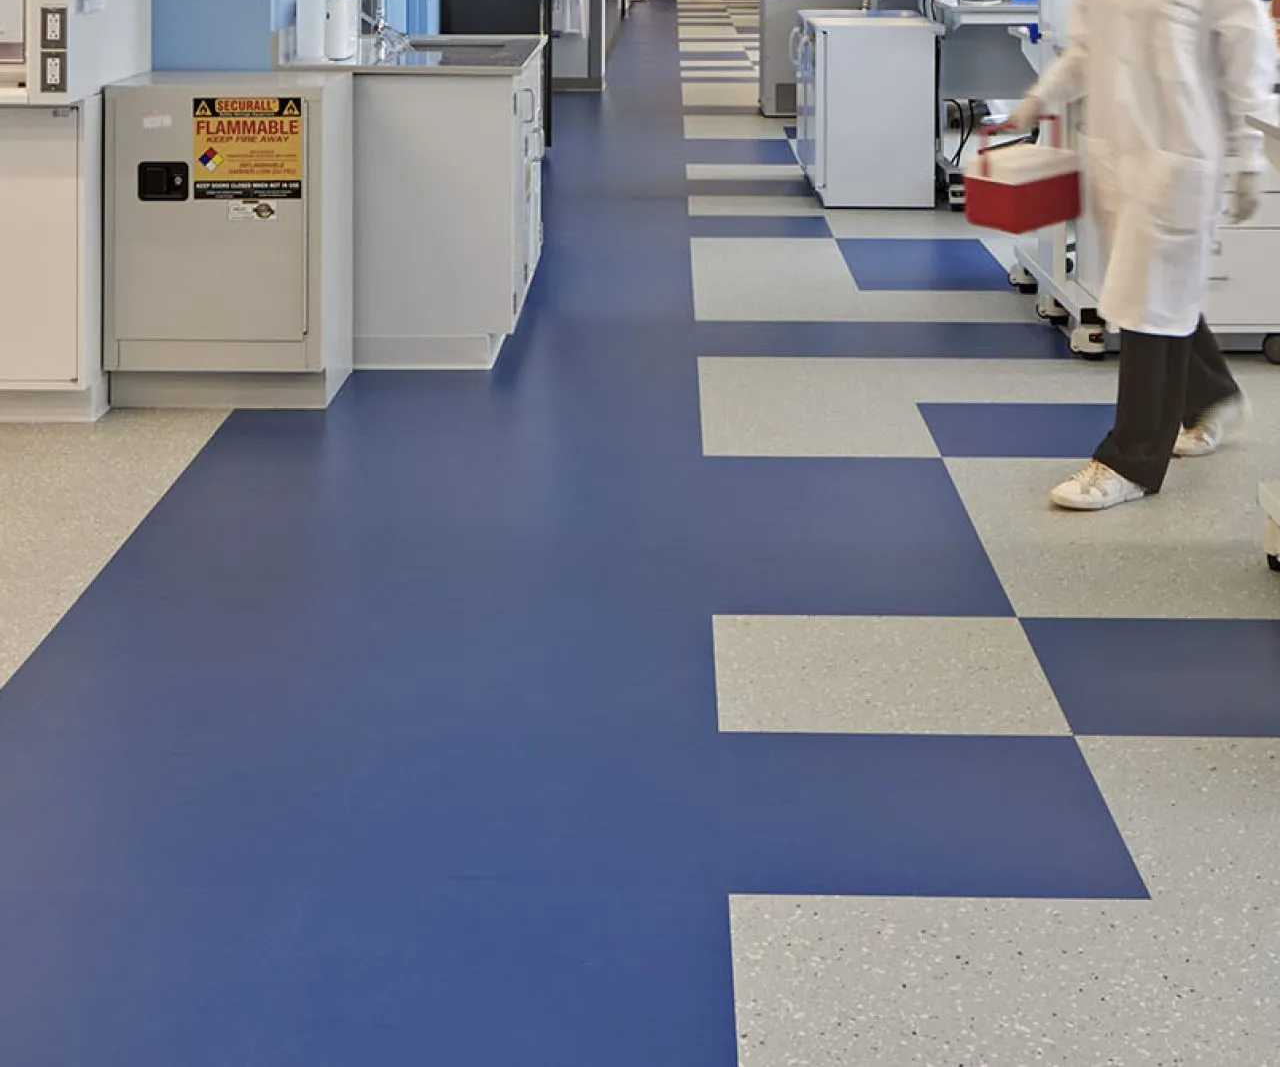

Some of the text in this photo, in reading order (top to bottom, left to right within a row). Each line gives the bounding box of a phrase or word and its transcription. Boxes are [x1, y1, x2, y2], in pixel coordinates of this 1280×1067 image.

[217, 100, 273, 111] SECURALL
[196, 120, 299, 135] FLAMMABLE
[207, 135, 289, 143] KEEP FIRE AWAY
